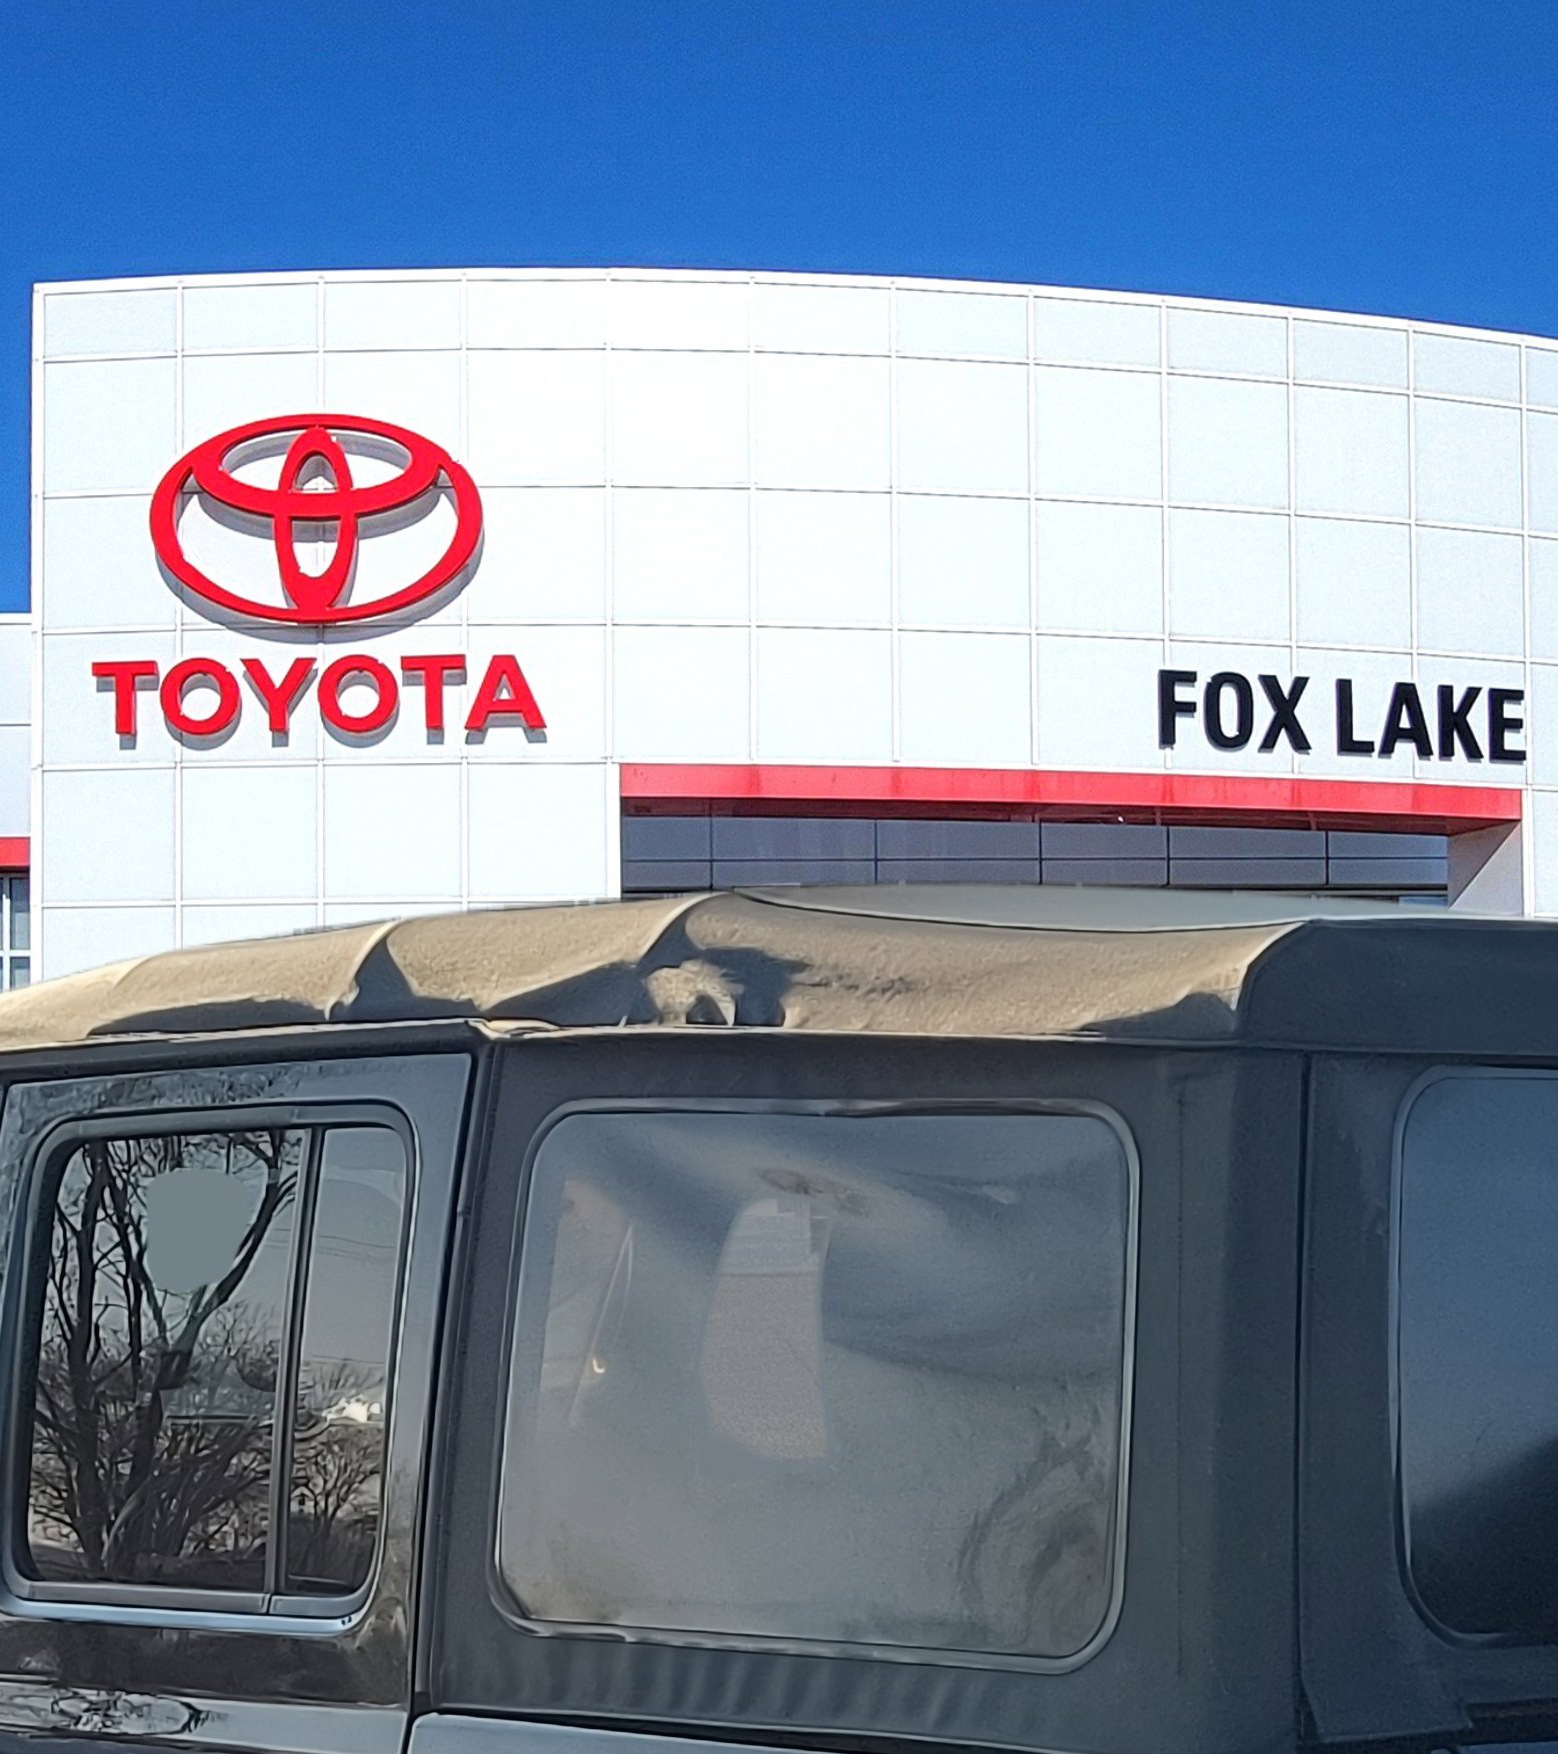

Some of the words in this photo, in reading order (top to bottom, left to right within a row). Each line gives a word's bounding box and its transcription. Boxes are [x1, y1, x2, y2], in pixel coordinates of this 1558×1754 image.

[92, 654, 548, 738] TOYOTA
[1158, 669, 1311, 752] FOX
[1335, 678, 1527, 762] LAKE
